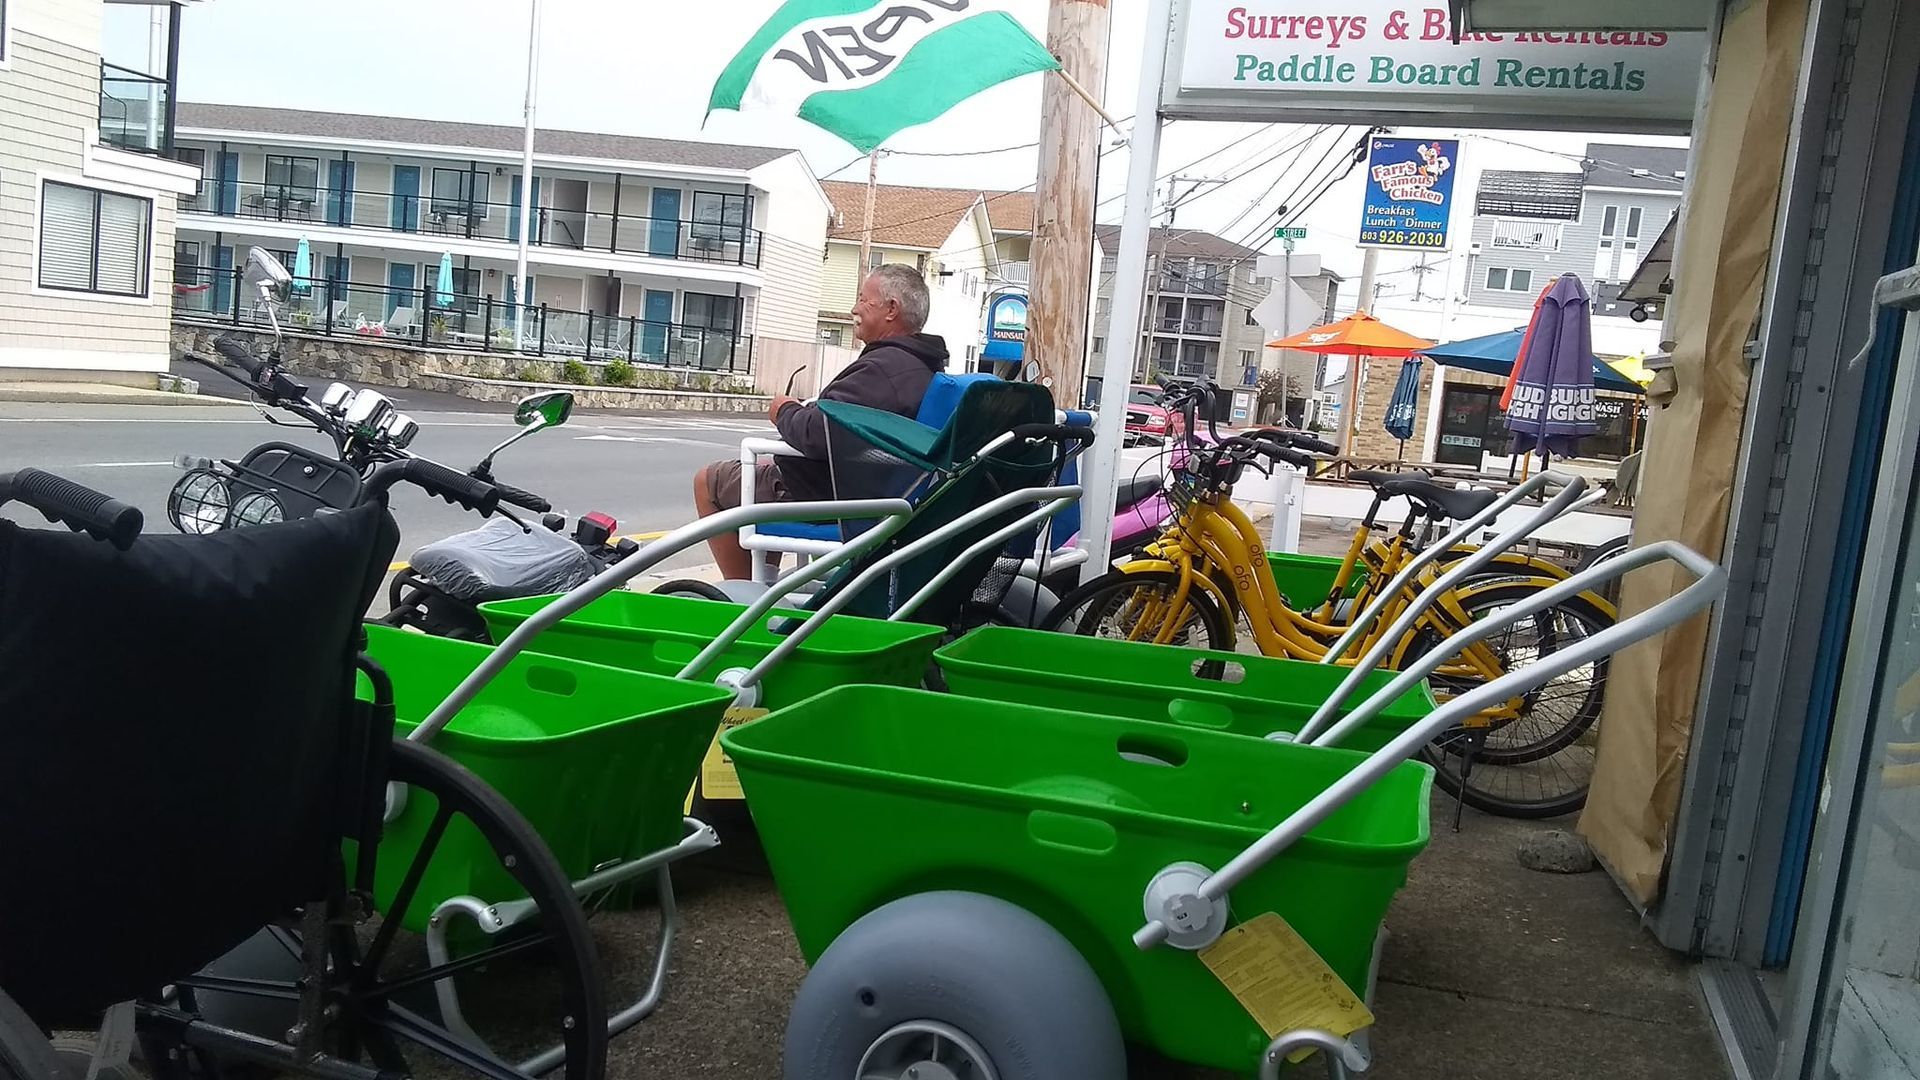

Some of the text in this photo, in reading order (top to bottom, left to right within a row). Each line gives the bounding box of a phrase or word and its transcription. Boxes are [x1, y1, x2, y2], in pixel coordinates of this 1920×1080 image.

[1225, 7, 1367, 48] Surreys
[1383, 10, 1409, 40] &
[1234, 54, 1646, 92] Paddle Board Rentals
[1373, 162, 1416, 179] Farr's
[1383, 176, 1433, 188] Famous
[1391, 188, 1442, 202] Chicken
[1367, 205, 1415, 216] Breakfast
[1365, 217, 1442, 229] Lunch Dinner
[1283, 229, 1306, 238] STREET
[1362, 231, 1377, 240] 603
[1444, 435, 1480, 447] OPEN
[1234, 565, 1250, 591] ofo
